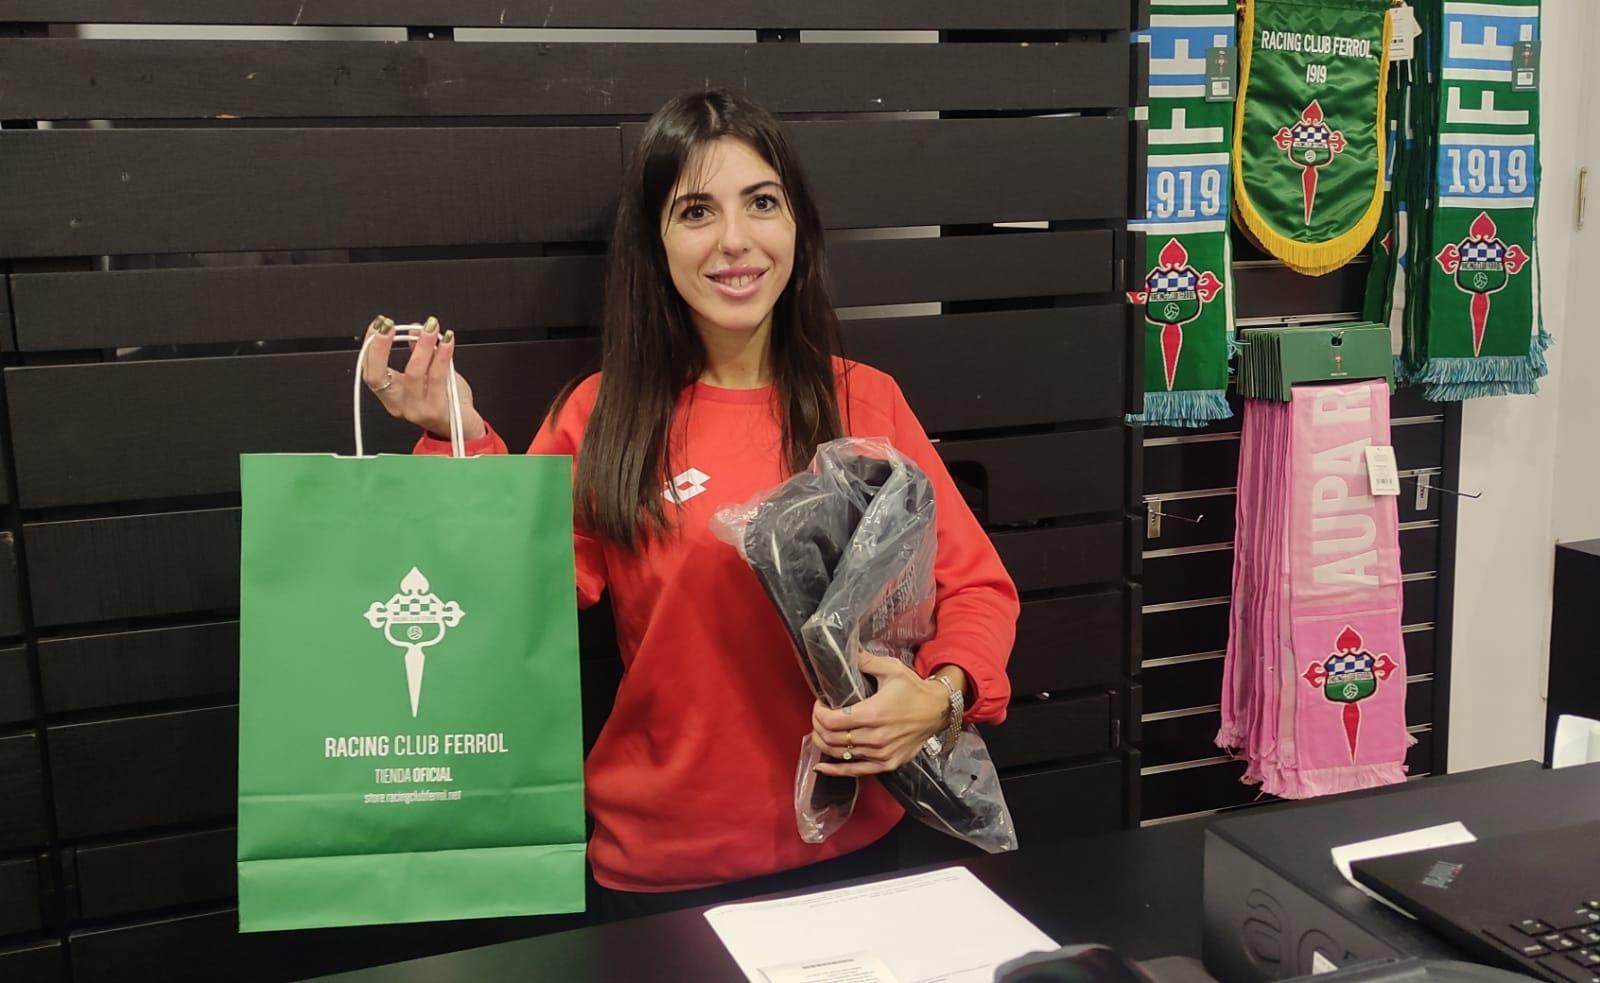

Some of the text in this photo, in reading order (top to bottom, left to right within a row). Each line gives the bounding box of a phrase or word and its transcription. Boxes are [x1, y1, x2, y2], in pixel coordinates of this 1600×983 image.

[1261, 30, 1302, 52] RACING
[1303, 34, 1332, 54] CLUB
[1332, 36, 1373, 58] FERROL
[1306, 63, 1327, 84] 1919
[1447, 148, 1528, 194] 1919
[1146, 168, 1220, 219] 919
[1312, 437, 1379, 587] AUPA
[325, 733, 508, 758] RACING CLUB FERROL
[375, 767, 453, 784] TIENDA OFICIAL
